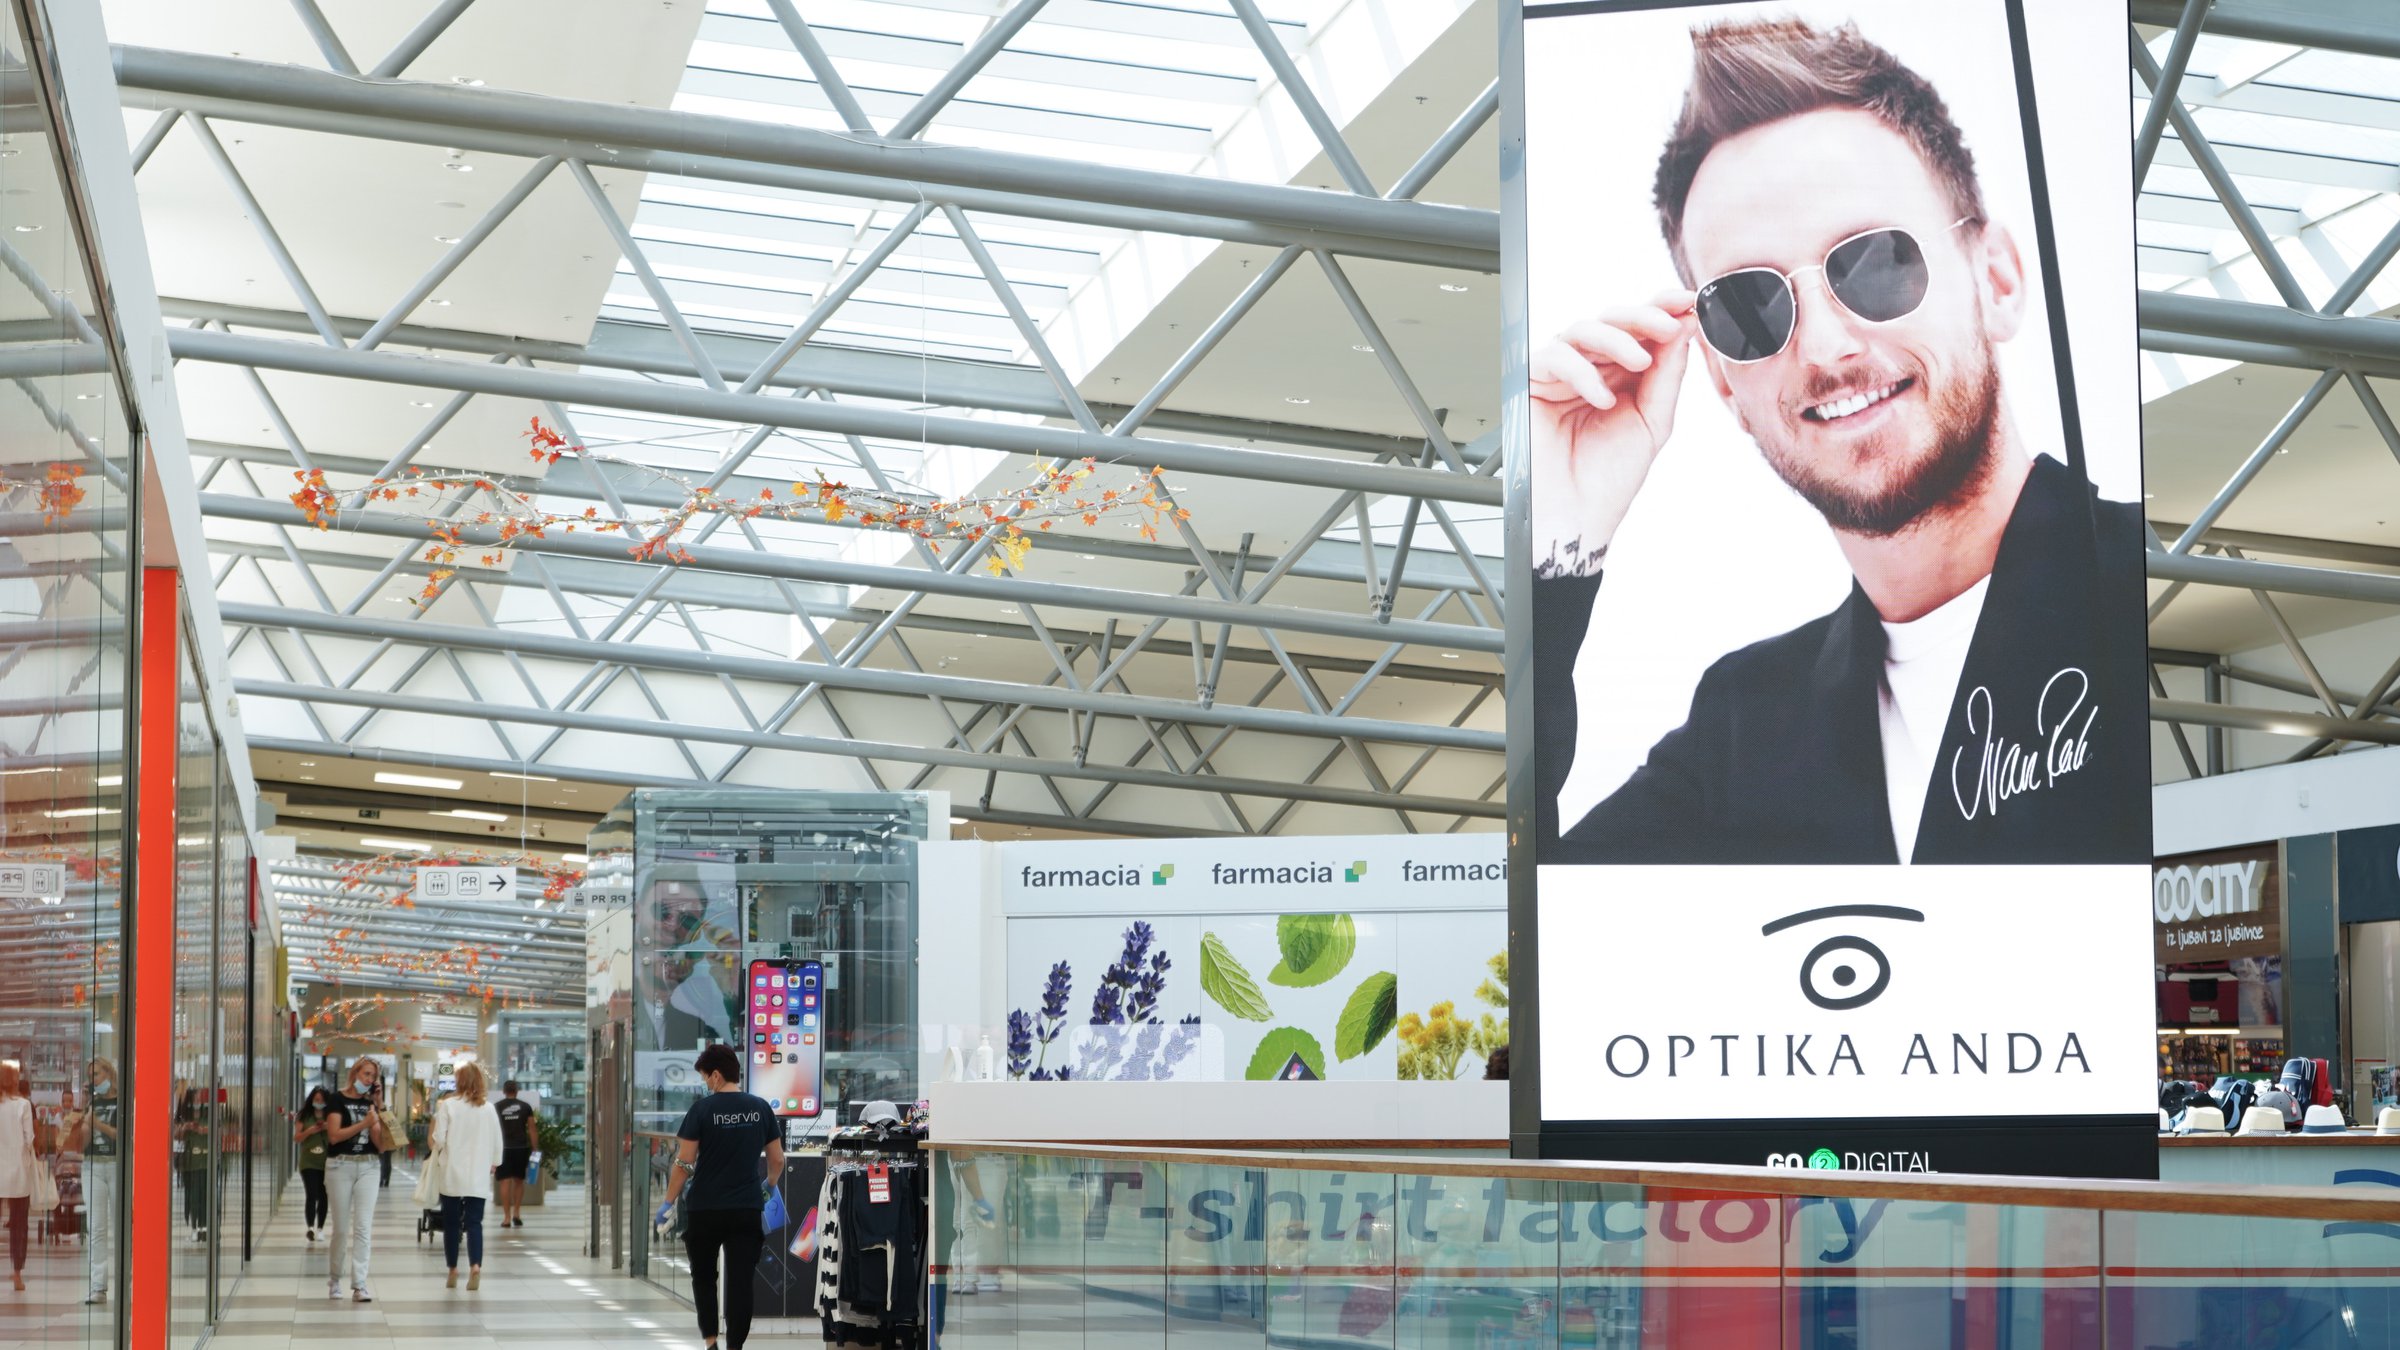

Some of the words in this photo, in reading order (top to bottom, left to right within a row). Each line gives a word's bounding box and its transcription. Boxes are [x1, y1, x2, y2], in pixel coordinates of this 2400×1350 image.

[461, 876, 477, 887] PR
[1021, 864, 1141, 888] farmacia
[1211, 861, 1333, 885] farmacia
[1402, 858, 1507, 882] farmaci
[591, 895, 606, 903] PR
[2153, 860, 2258, 924] OOCITY
[2166, 929, 2176, 946] iz
[2210, 928, 2222, 943] za
[1605, 1033, 1866, 1079] OPTIKA
[1901, 1031, 2093, 1075] ANDA
[713, 1110, 760, 1125] Inservio
[1844, 1152, 1939, 1173] DIGITAL
[1067, 1171, 1446, 1243] T-shirt
[1482, 1178, 1895, 1264] factory
